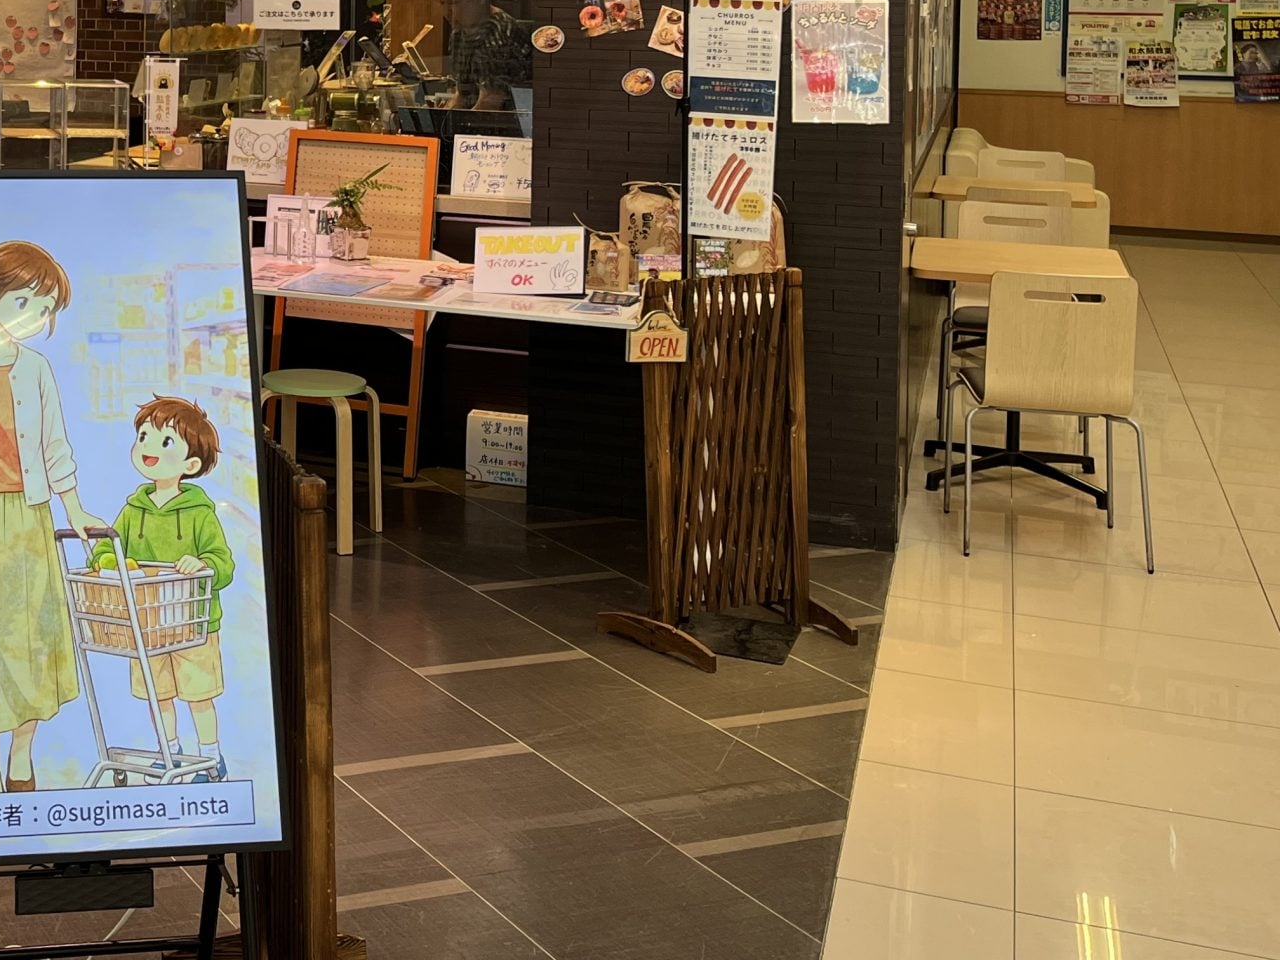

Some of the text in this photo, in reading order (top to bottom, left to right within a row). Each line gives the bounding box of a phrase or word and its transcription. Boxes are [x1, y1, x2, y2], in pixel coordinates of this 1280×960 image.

[799, 12, 878, 29] ちゅるんとソーダ
[692, 132, 767, 144] 揚げたてチュロス
[460, 141, 479, 153] Good
[479, 234, 580, 255] TAKEOUT
[486, 258, 547, 269] すべてのメニュー
[511, 274, 534, 286] OK
[640, 337, 680, 357] OPEN
[481, 421, 523, 436] 営業時間
